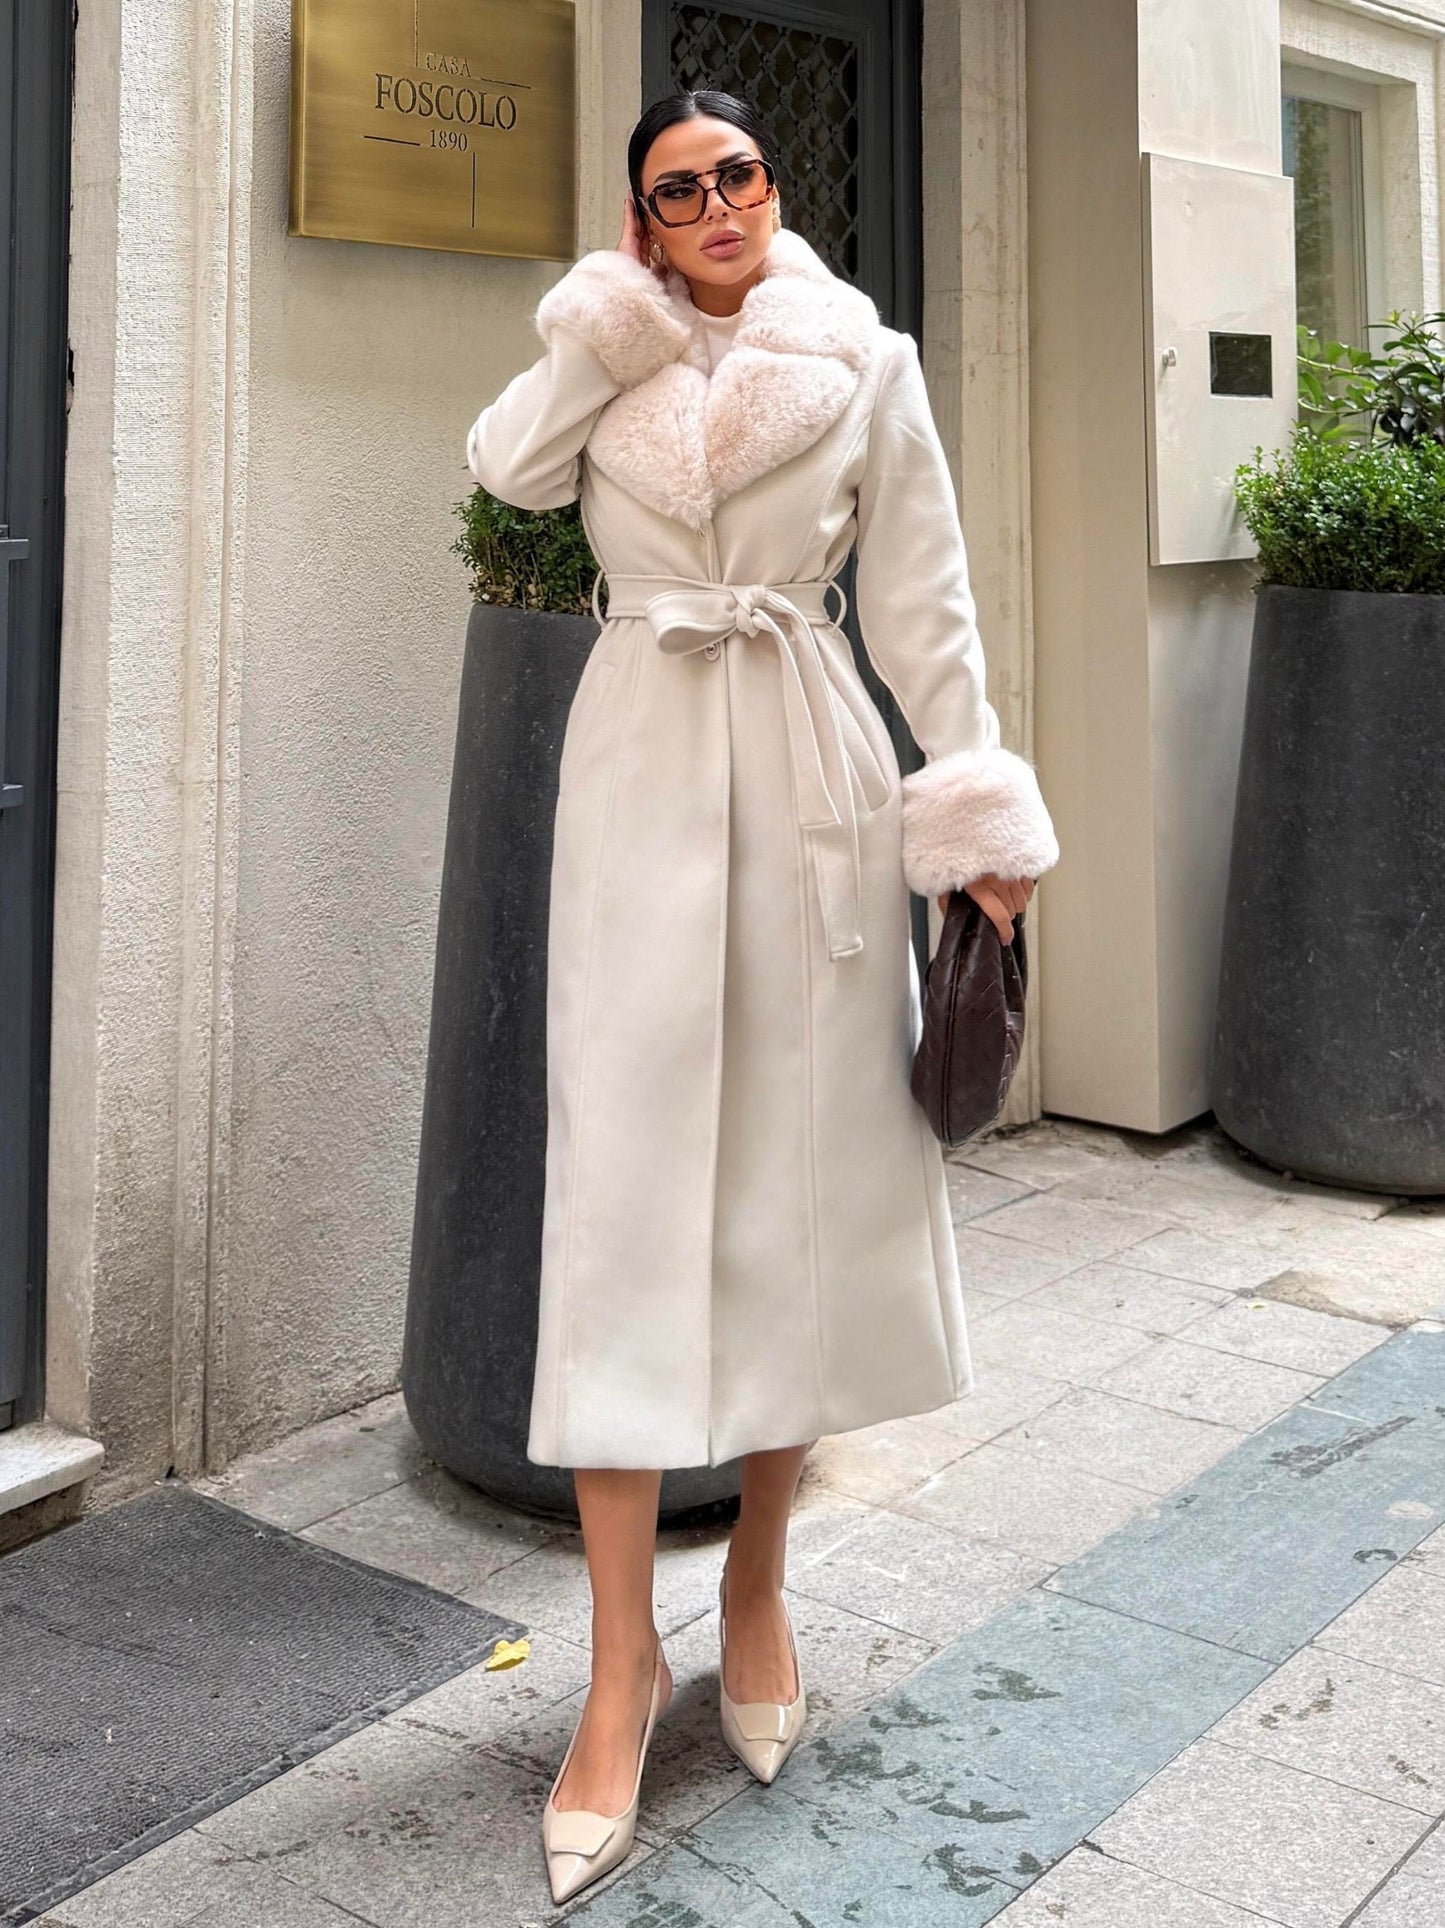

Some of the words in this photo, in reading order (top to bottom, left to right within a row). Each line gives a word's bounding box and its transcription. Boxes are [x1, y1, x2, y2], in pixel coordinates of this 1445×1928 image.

[426, 53, 471, 78] CASA
[375, 73, 517, 130] FOSCOLO
[429, 129, 468, 152] 1890
